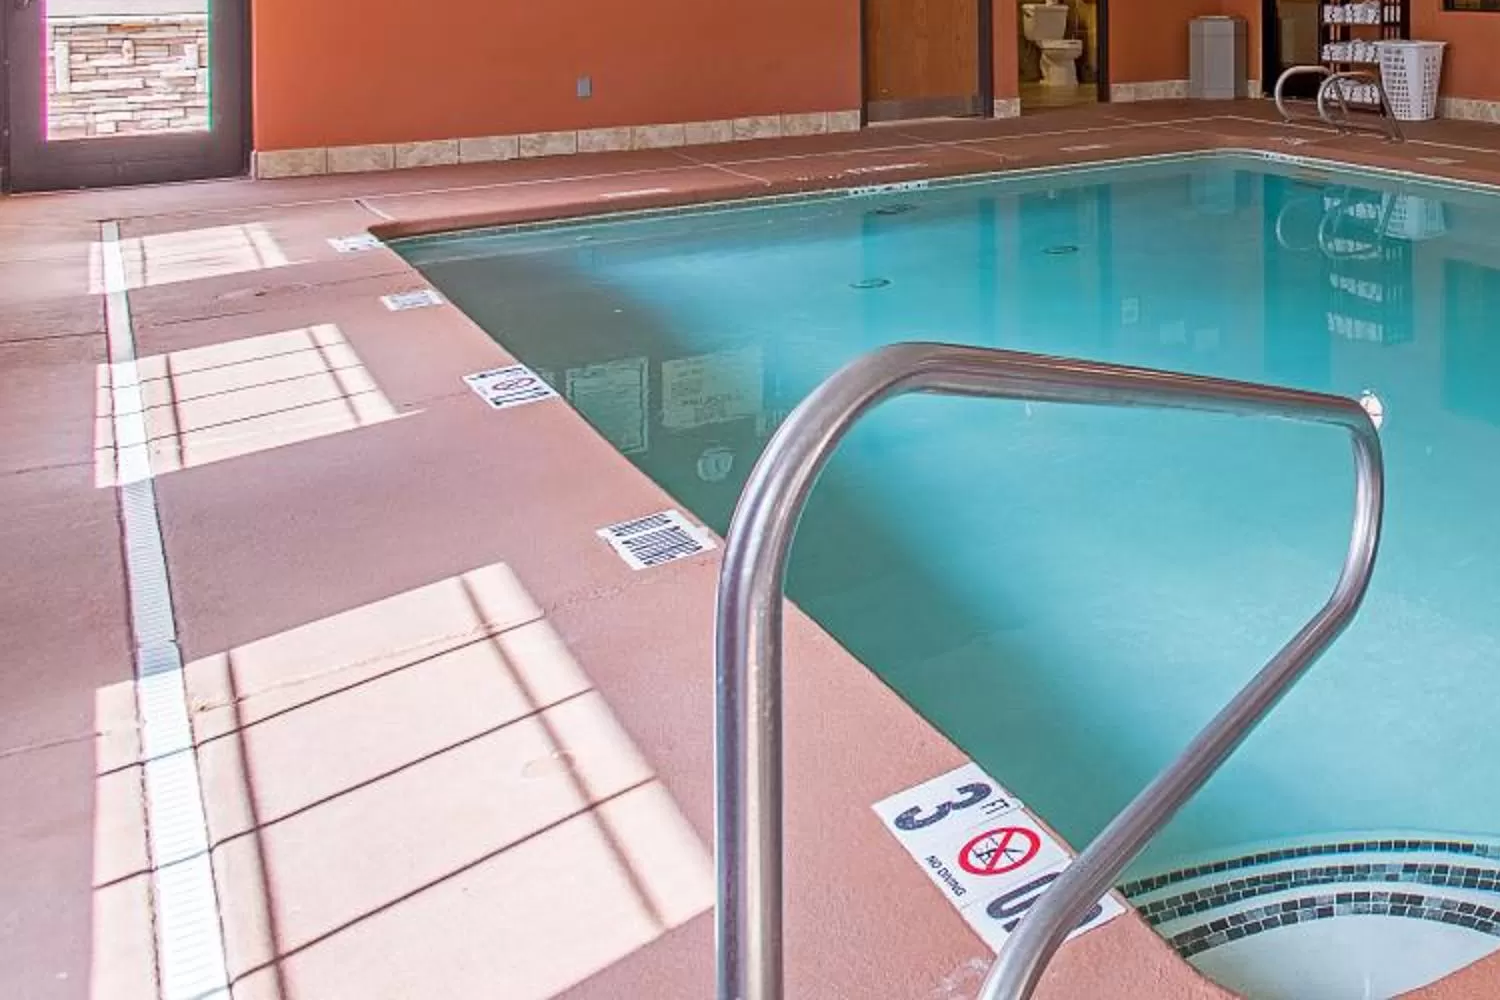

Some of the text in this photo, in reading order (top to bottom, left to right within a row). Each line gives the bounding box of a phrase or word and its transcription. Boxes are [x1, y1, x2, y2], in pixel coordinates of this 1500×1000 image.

[894, 782, 1010, 831] 3 FT
[926, 854, 967, 897] NO DIVING
